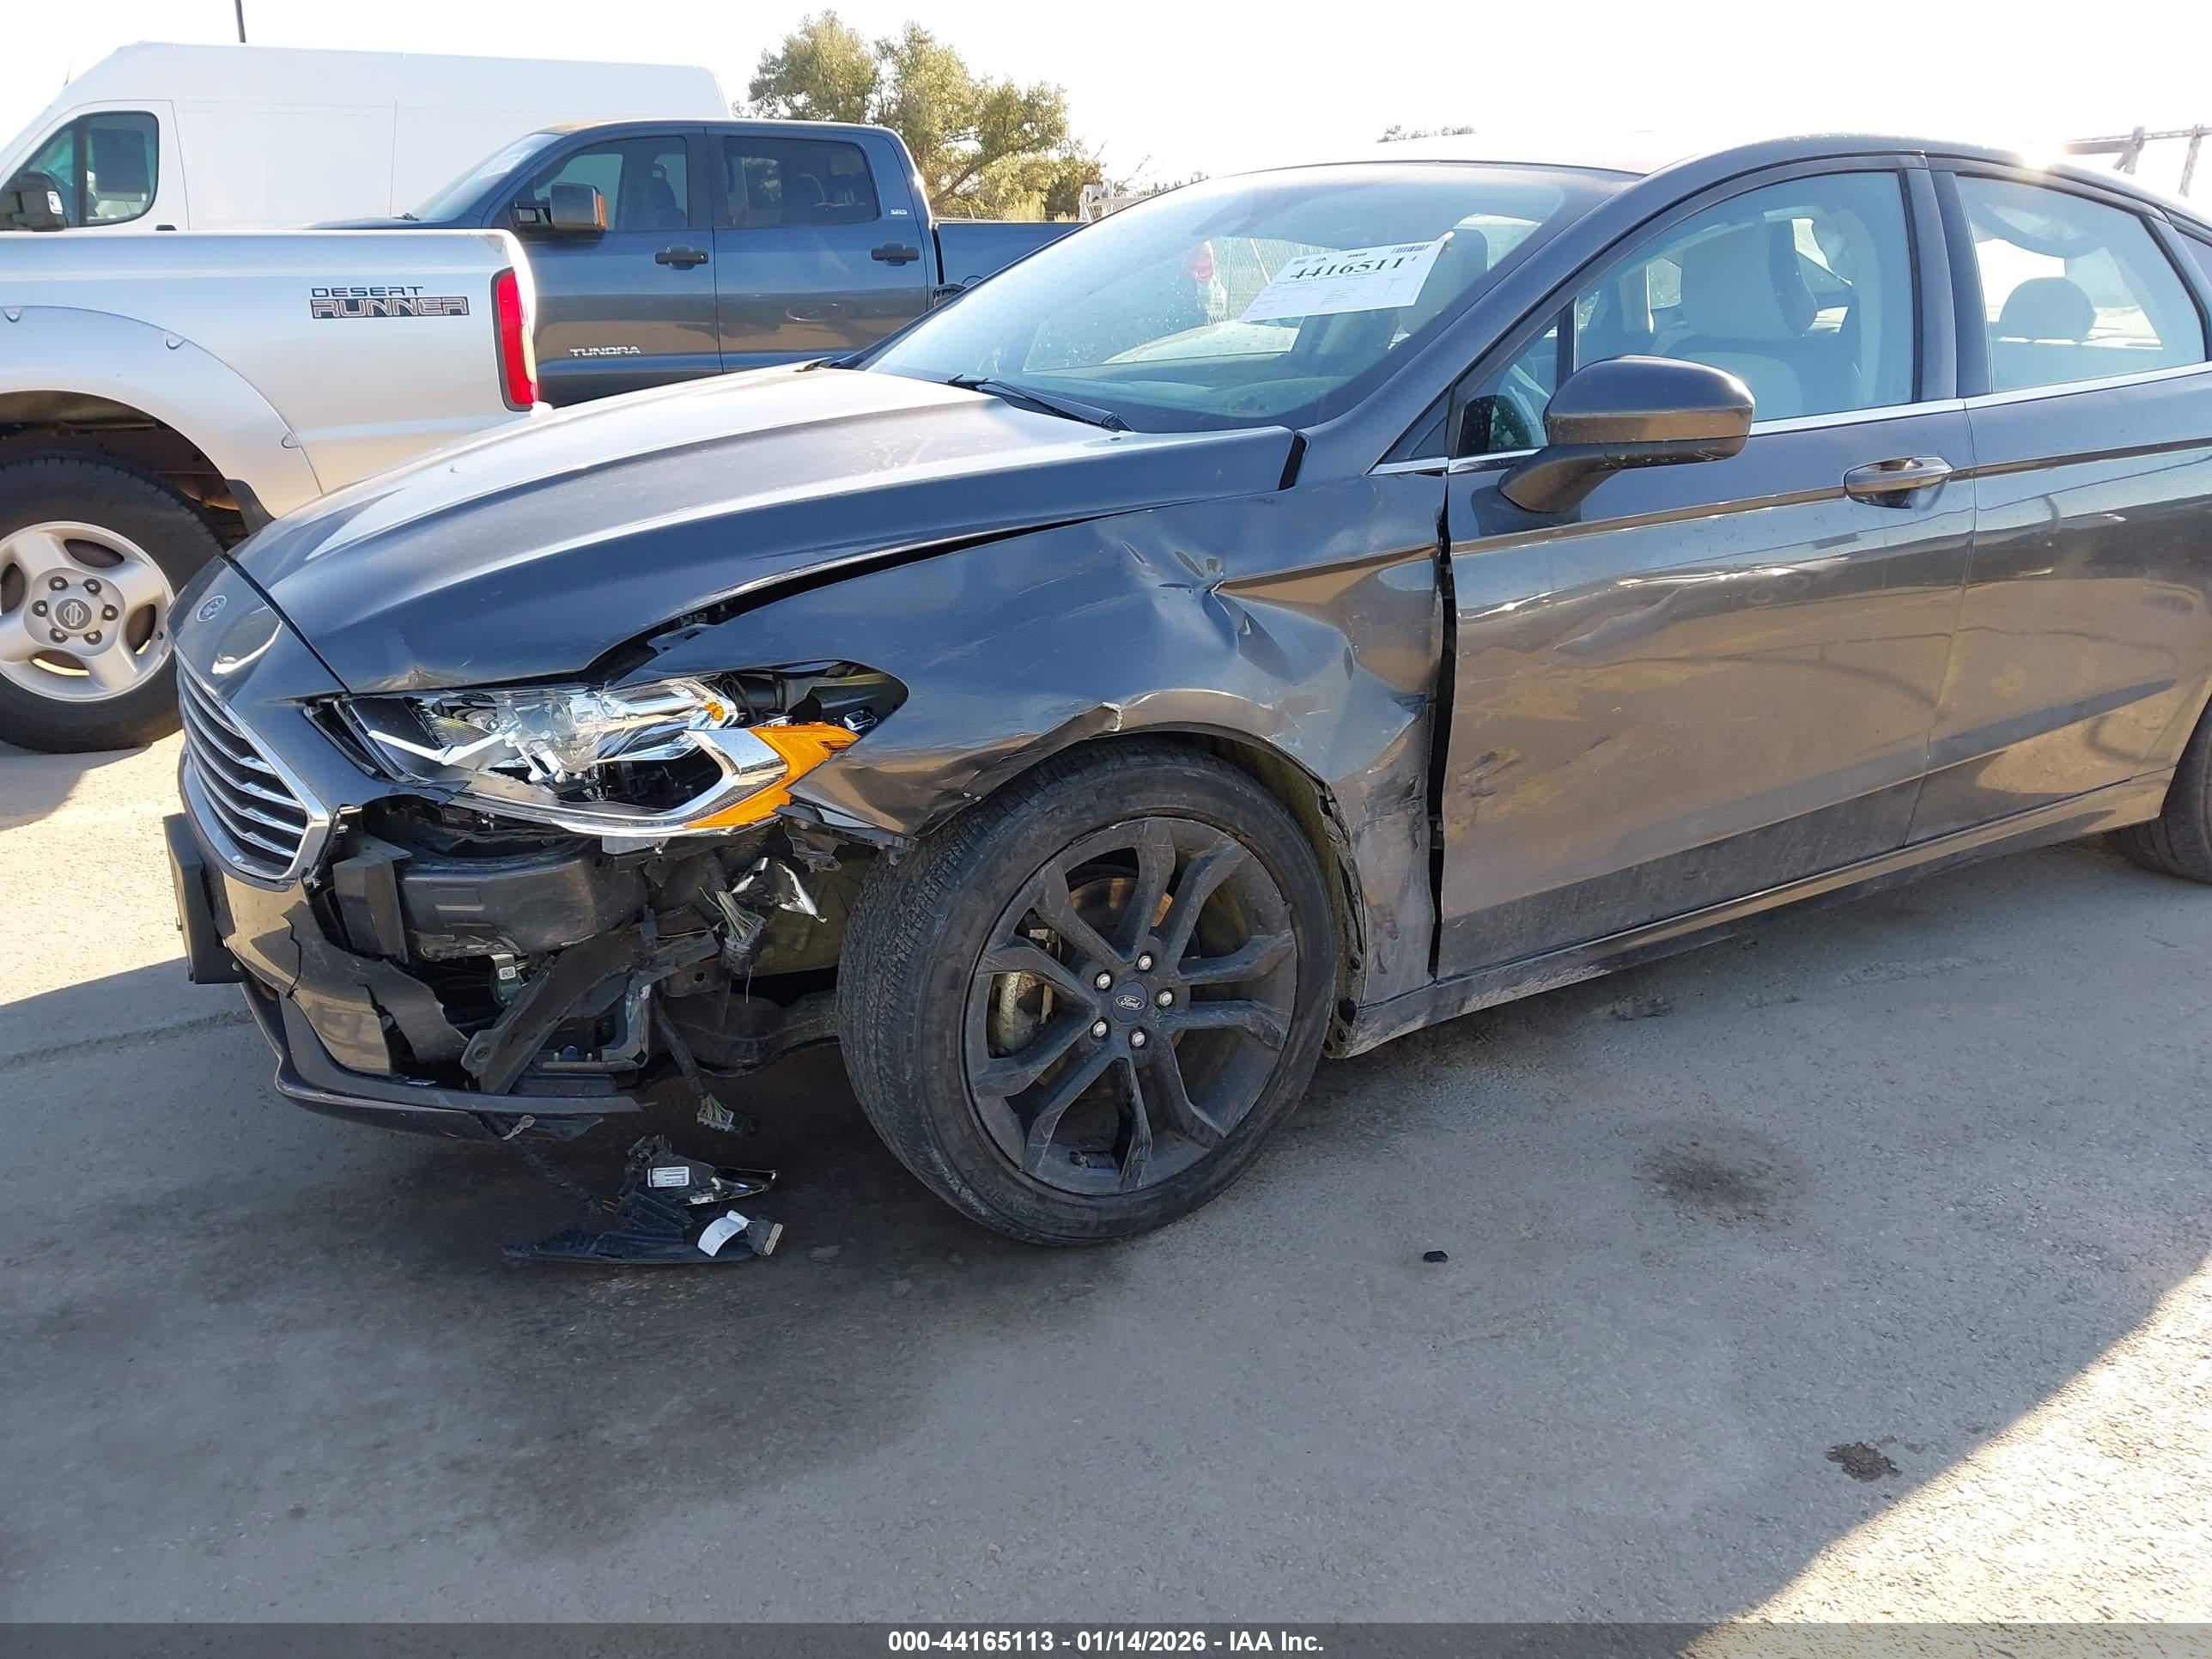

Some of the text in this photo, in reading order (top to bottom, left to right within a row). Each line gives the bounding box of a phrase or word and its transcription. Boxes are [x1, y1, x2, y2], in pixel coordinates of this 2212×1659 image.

[311, 286, 424, 298] DESERT
[311, 297, 469, 319] RUNNER
[568, 345, 641, 357] TUNDRA
[1120, 996, 1141, 1008] Ford
